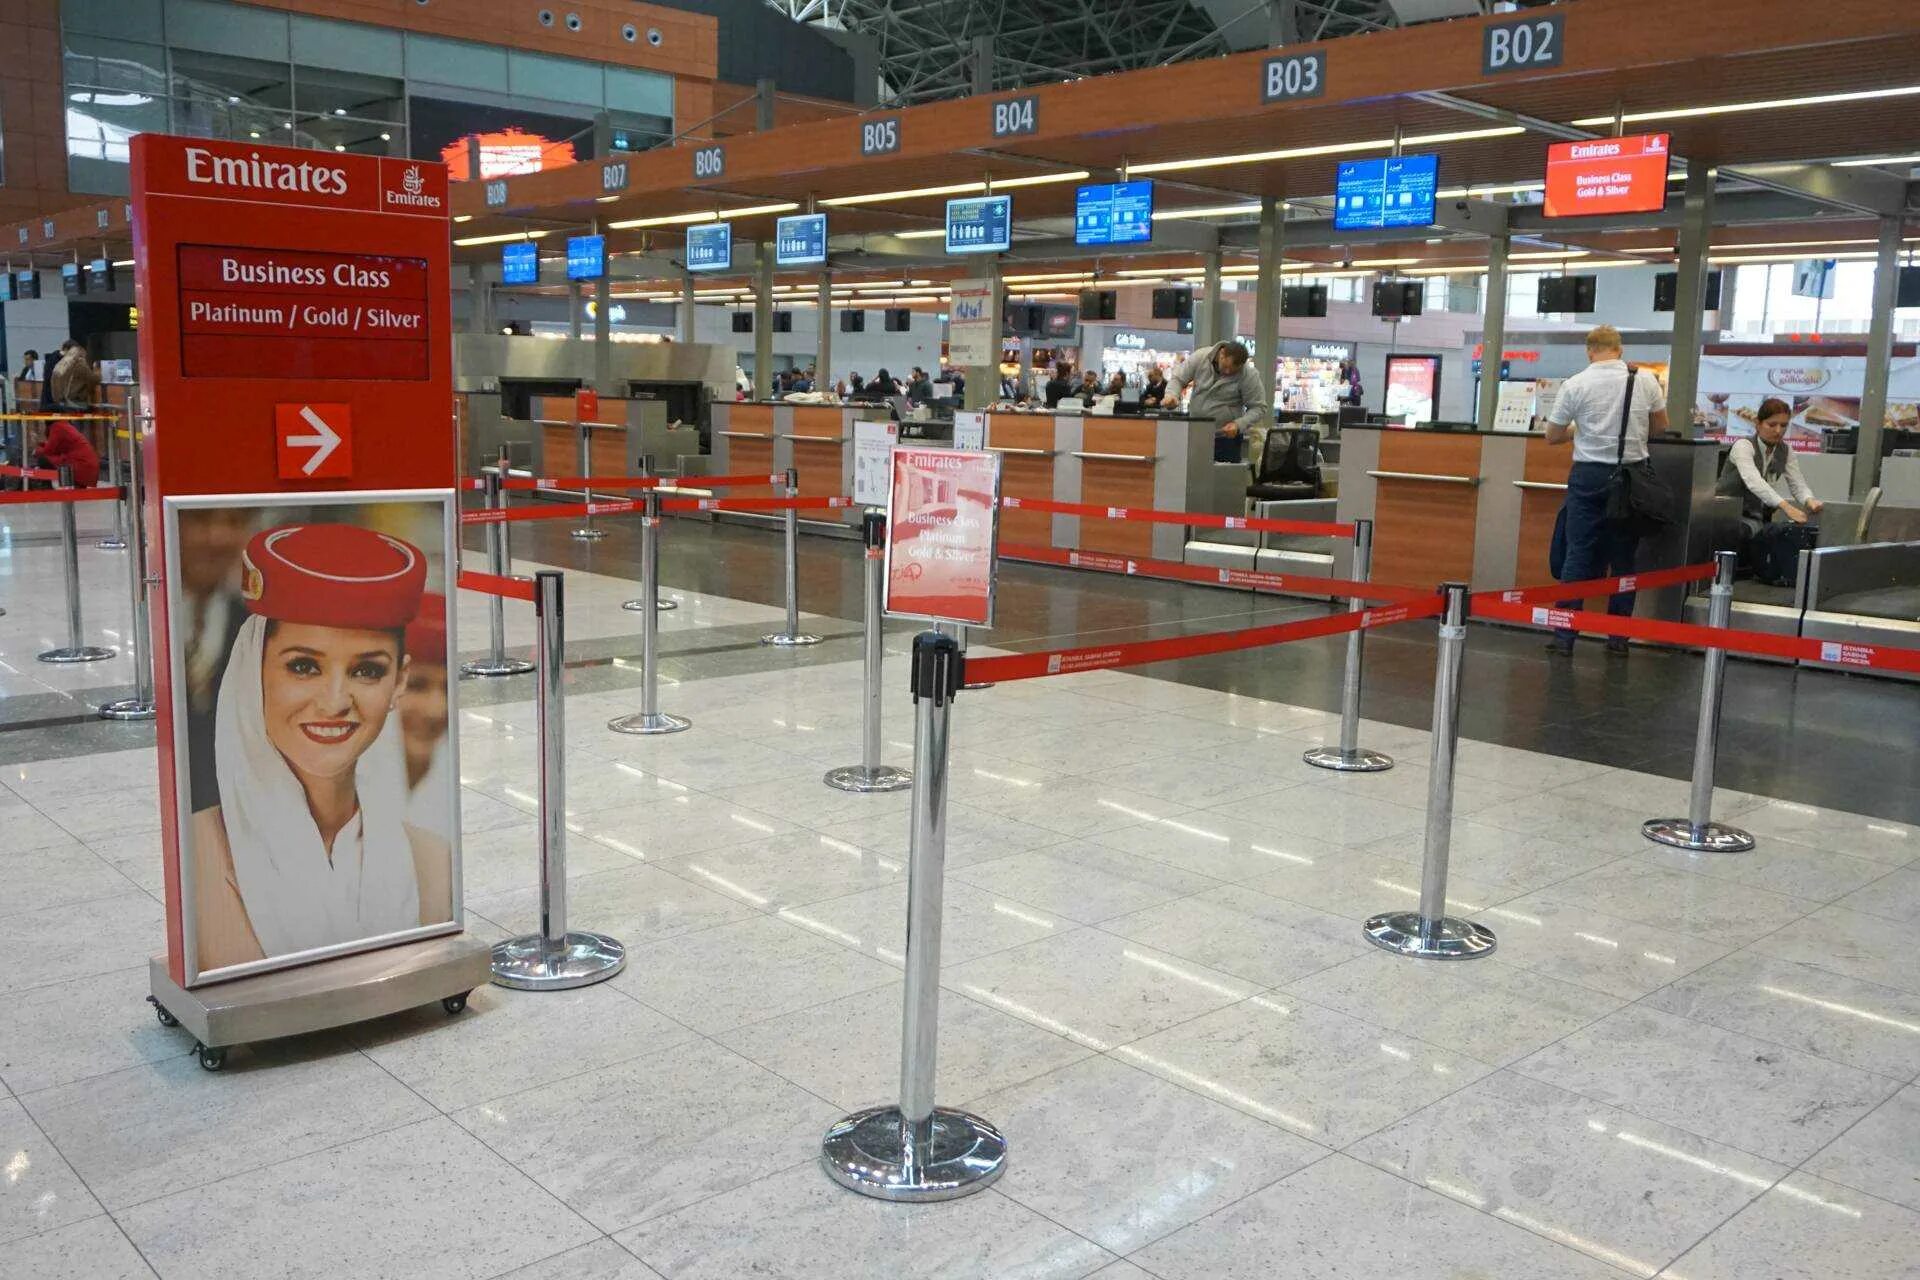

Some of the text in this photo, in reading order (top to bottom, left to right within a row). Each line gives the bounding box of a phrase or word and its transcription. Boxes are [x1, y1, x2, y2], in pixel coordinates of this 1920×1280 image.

[1490, 21, 1554, 68] B02
[1267, 56, 1318, 97] B03
[995, 99, 1033, 134] B04
[864, 120, 897, 152] B05
[695, 148, 722, 176] B06
[1571, 143, 1620, 159] Emirates
[185, 147, 348, 195] Emirates
[603, 164, 626, 189] B07
[1576, 172, 1632, 186] Business Class
[386, 190, 440, 208] Emirates
[487, 182, 506, 205] B08
[1577, 187, 1596, 198] Gold
[1606, 184, 1630, 195] Silver
[222, 258, 391, 288] Business Class
[191, 302, 421, 331] Platinum / Gold / Silver
[906, 451, 962, 469] Emirates
[908, 511, 952, 527] Business
[920, 530, 965, 545] Platinum
[908, 544, 932, 559] Gold
[944, 549, 976, 564] Silver
